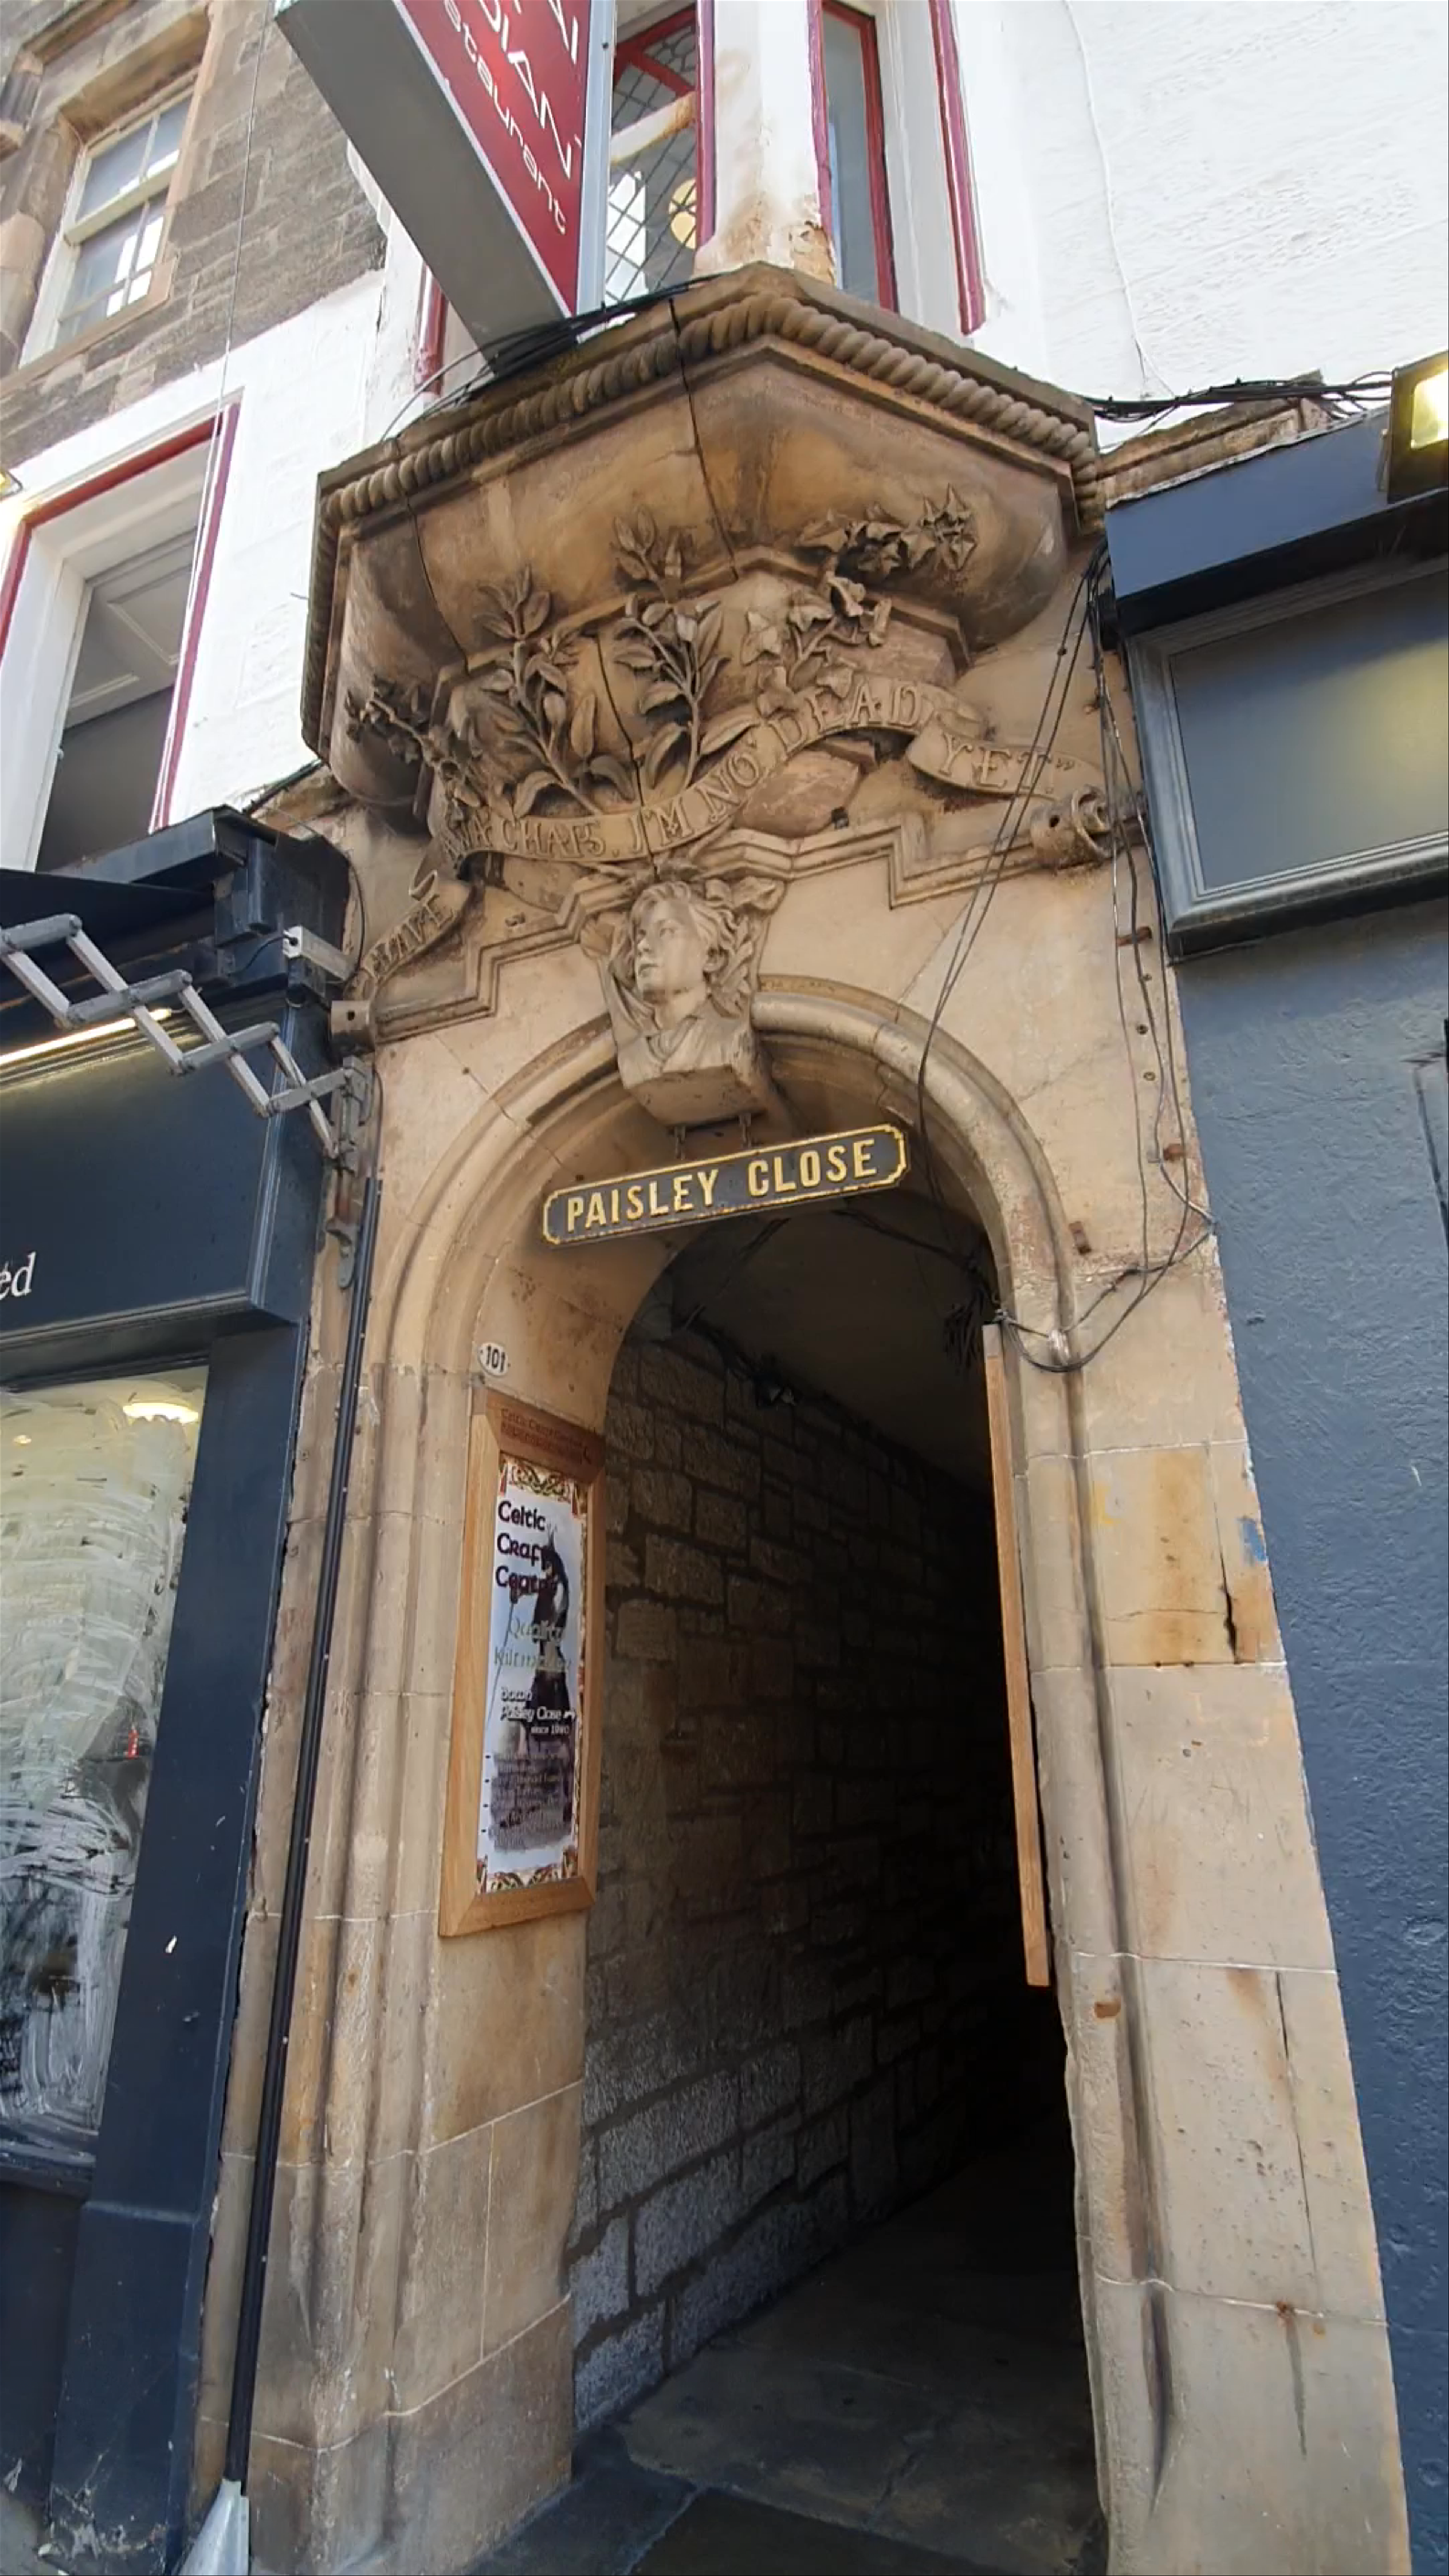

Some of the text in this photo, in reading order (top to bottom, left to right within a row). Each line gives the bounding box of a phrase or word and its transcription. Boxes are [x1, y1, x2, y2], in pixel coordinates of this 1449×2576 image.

[768, 683, 920, 754] DEAD
[567, 1138, 877, 1232] PAISLEY CLOSE
[486, 1345, 506, 1373] 101
[498, 1500, 546, 1531] Celtic
